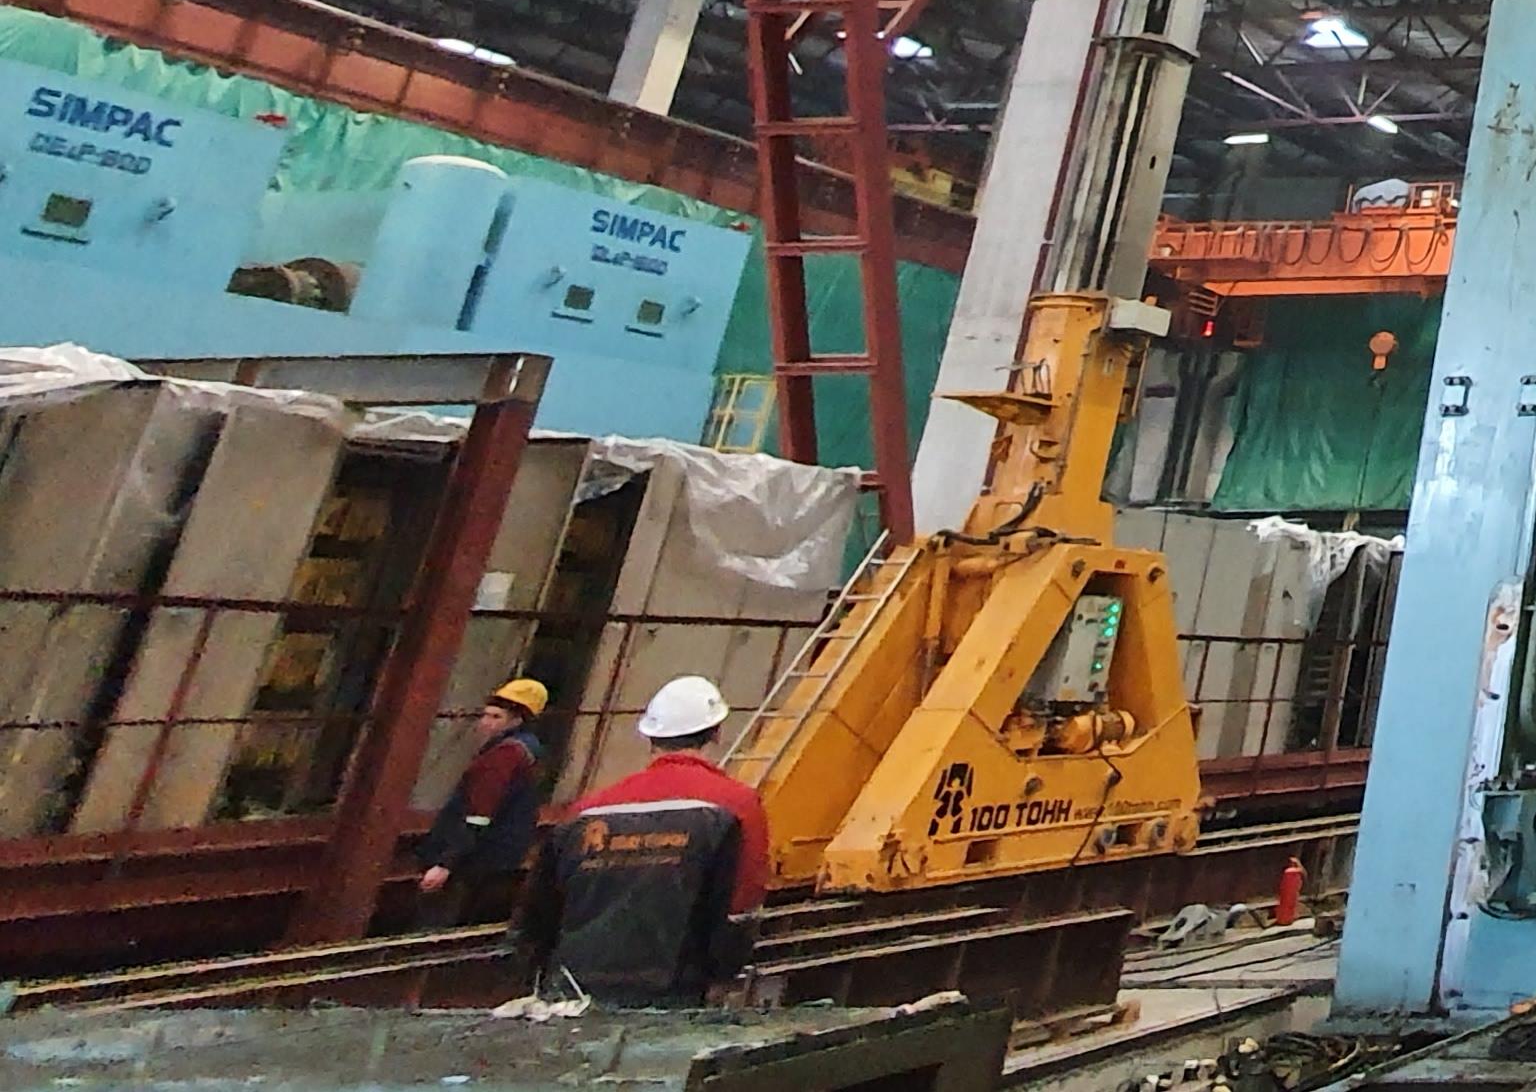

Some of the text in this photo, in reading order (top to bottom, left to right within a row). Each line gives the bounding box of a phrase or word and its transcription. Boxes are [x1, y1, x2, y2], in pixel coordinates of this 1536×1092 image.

[25, 86, 183, 148] SIMPAC
[590, 209, 687, 253] SIMPAC
[969, 798, 1073, 832] 100 ТОНН
